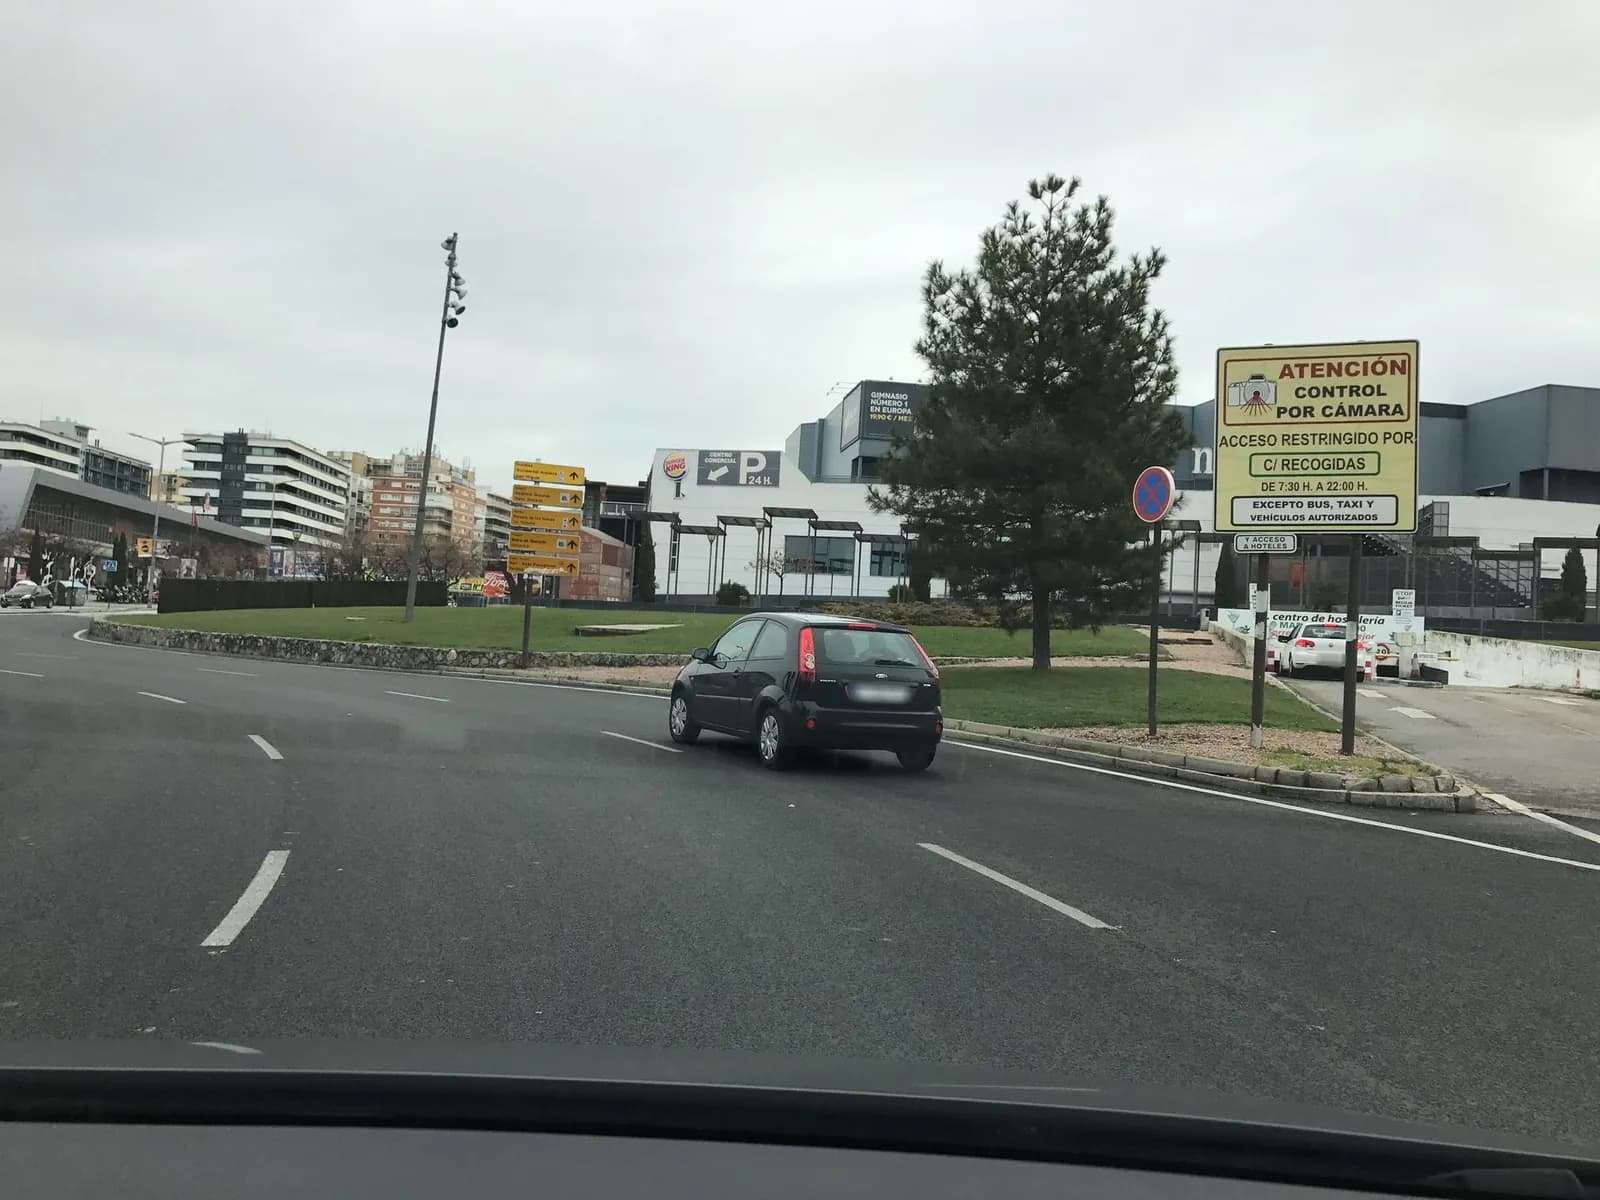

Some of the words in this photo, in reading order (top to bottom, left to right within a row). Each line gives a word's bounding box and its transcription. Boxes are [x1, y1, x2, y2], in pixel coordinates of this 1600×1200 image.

[1279, 357, 1407, 379] ATENCIÓN
[1294, 384, 1387, 398] CONTROL
[882, 406, 912, 414] EUROPA
[1277, 406, 1315, 418] POR
[1322, 402, 1404, 417] CÁMARA
[1219, 434, 1277, 447] ACCESO
[1282, 432, 1378, 446] RESTRINGIDO
[1383, 432, 1414, 445] POR
[666, 462, 685, 471] KING
[1264, 459, 1277, 472] C/
[1282, 458, 1365, 471] RECOGIDAS
[1261, 482, 1275, 491] DE
[1279, 482, 1299, 491] 7:30
[1303, 482, 1313, 491] H.
[1316, 482, 1323, 491] A
[1327, 481, 1354, 491] 22:00
[1357, 481, 1368, 491] H.
[1253, 501, 1303, 509] EXCEPTO
[1308, 501, 1333, 510] BUS,
[1337, 500, 1362, 508] TAXI
[1366, 500, 1374, 508] Y
[1250, 513, 1305, 521] VEHÍCULOS
[1308, 513, 1378, 521] AUTORIZADOS
[1273, 614, 1309, 622] centro
[1311, 614, 1325, 622] de
[1328, 614, 1385, 625] hoslería
